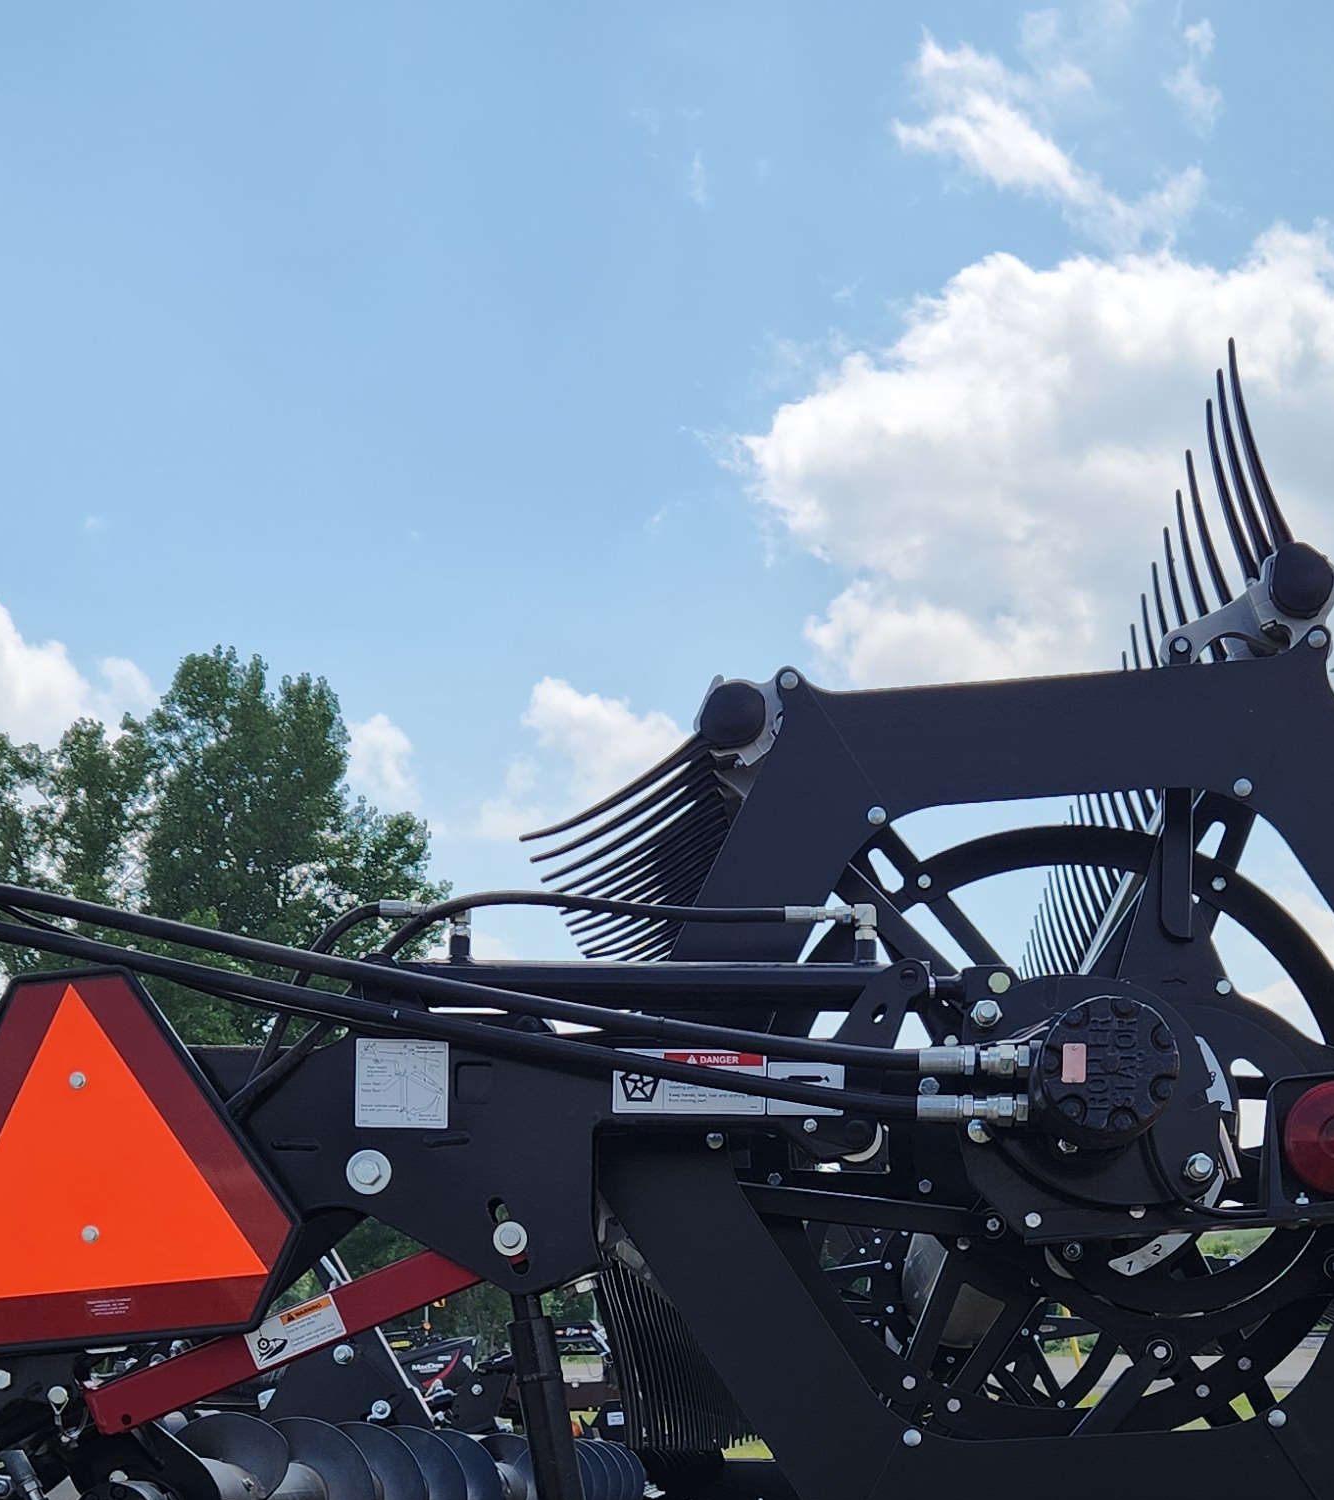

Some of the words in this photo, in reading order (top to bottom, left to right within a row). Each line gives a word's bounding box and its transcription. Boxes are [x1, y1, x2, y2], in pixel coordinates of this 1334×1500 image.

[699, 1055, 739, 1064] DANGER
[1125, 1259, 1134, 1273] 1
[1151, 1243, 1164, 1257] 2
[295, 1303, 322, 1317] WARNING
